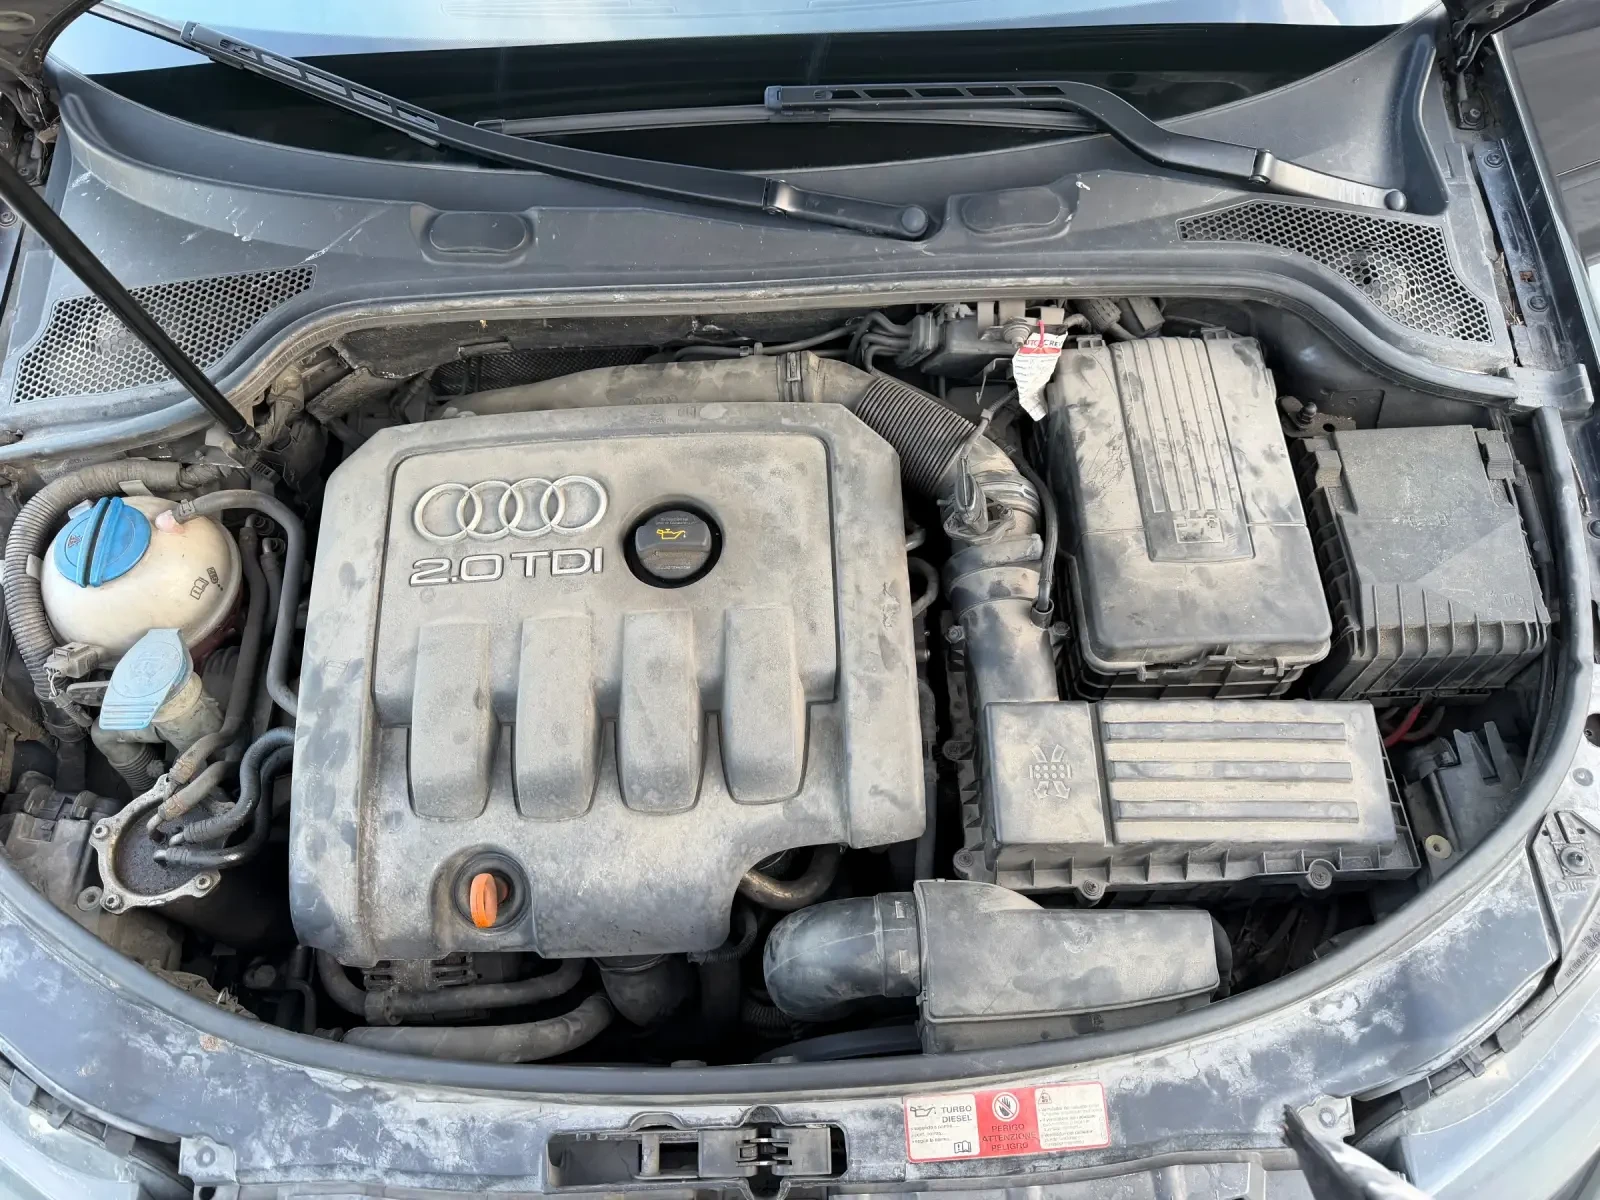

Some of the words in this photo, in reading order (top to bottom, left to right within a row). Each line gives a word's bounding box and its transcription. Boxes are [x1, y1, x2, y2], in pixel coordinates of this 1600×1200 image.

[409, 554, 503, 587] 2.0
[510, 547, 604, 578] TDI
[940, 1104, 972, 1114] TURBO
[942, 1114, 973, 1123] DIESEL
[991, 1123, 1025, 1132] PERIGO
[982, 1131, 1037, 1143] ATTENZIONE
[991, 1142, 1029, 1151] PELIGRO
